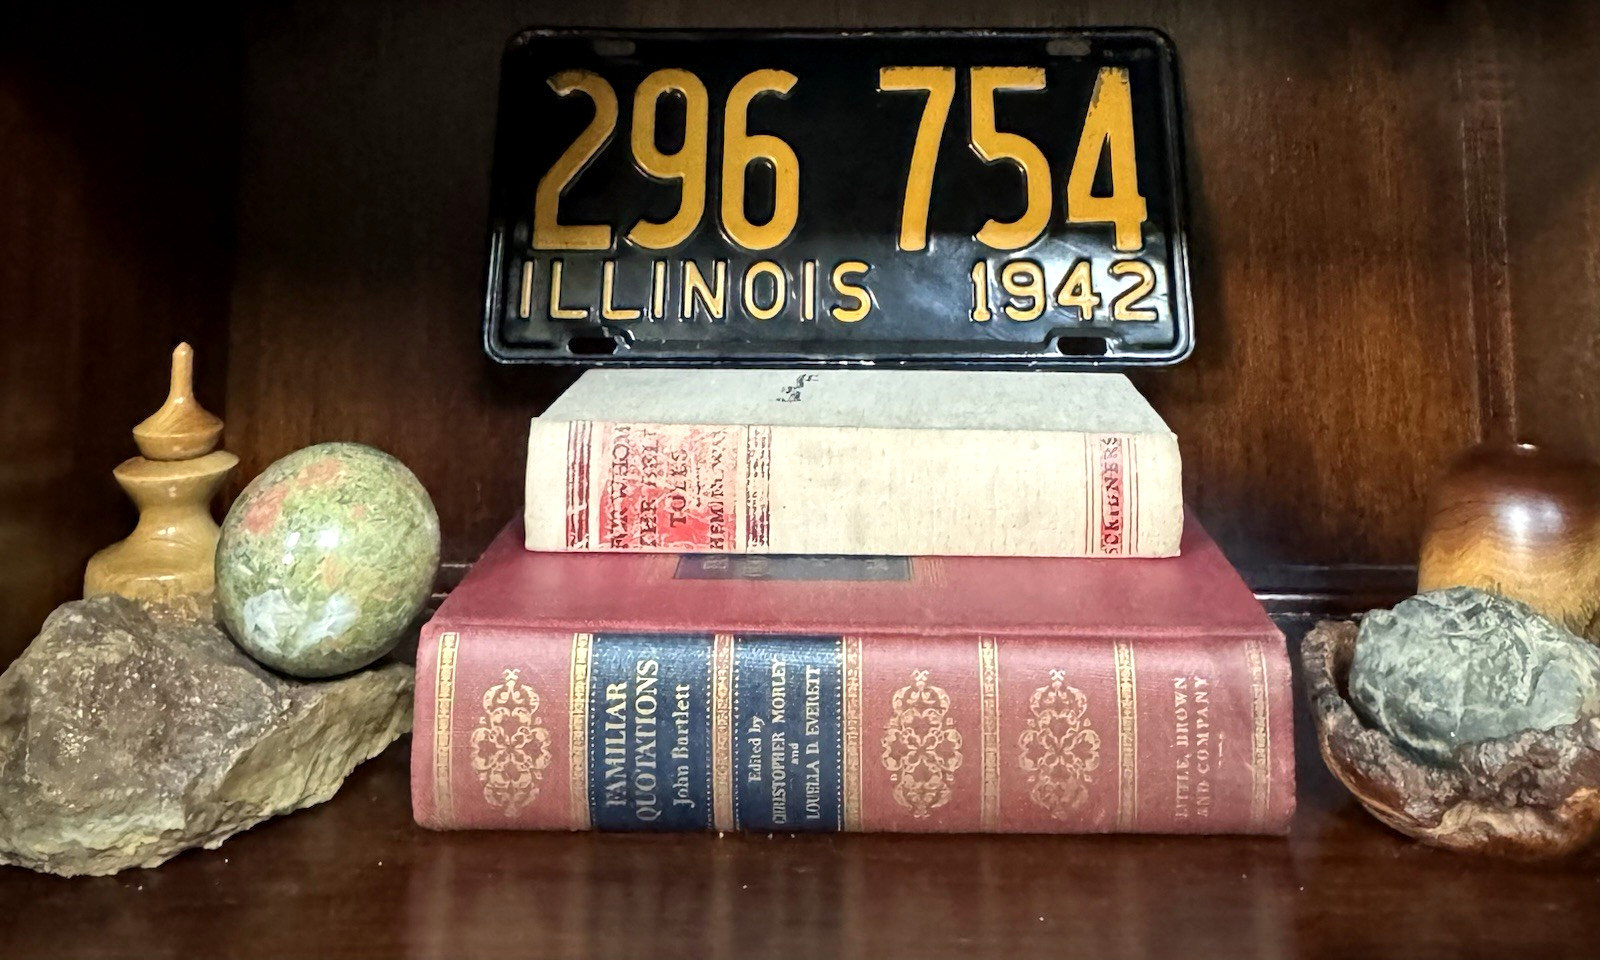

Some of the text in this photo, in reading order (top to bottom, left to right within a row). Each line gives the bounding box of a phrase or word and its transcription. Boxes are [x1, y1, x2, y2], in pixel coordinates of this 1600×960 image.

[533, 66, 1148, 252] 296 754
[520, 260, 1158, 322] ILLINOIS 1942
[604, 681, 628, 807] FAMILIAR
[634, 659, 661, 822] QUOTATIONS
[672, 684, 696, 809] John Bartlett
[748, 714, 765, 783] Edited by
[771, 655, 787, 825] CHRISTOPHER MORLEY
[806, 664, 820, 736] EVERETT
[1173, 676, 1190, 748] BROWN
[1194, 674, 1210, 818] AND COMPANY
[788, 742, 799, 765] and
[806, 760, 820, 820] LOUELLA
